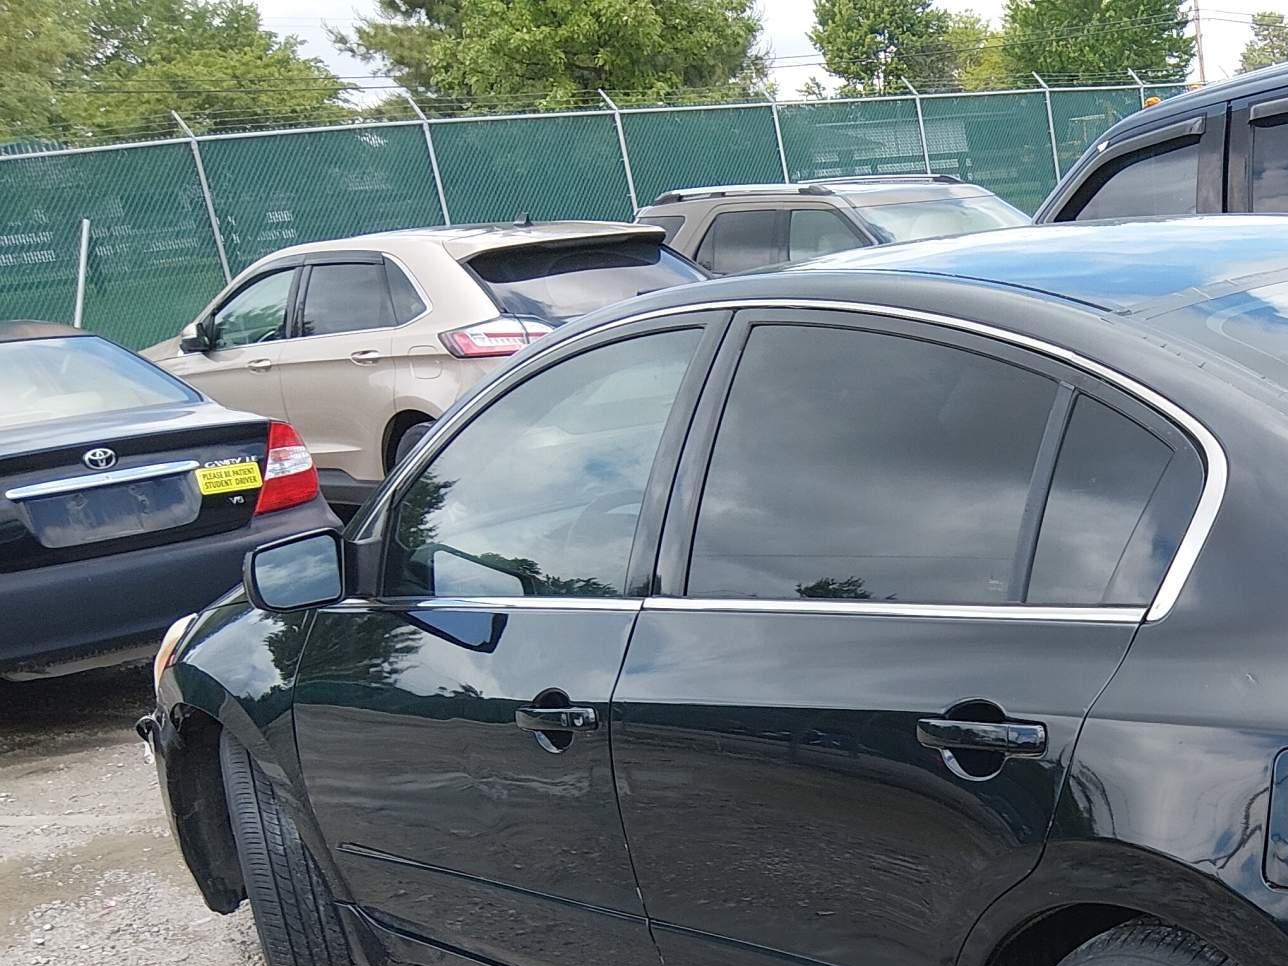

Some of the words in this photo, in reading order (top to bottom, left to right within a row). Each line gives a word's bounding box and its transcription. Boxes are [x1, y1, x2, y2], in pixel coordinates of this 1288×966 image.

[202, 471, 223, 480] PLEASE
[232, 467, 255, 476] PATIENT
[204, 478, 233, 490] STUDENT
[235, 475, 258, 485] DRIVER
